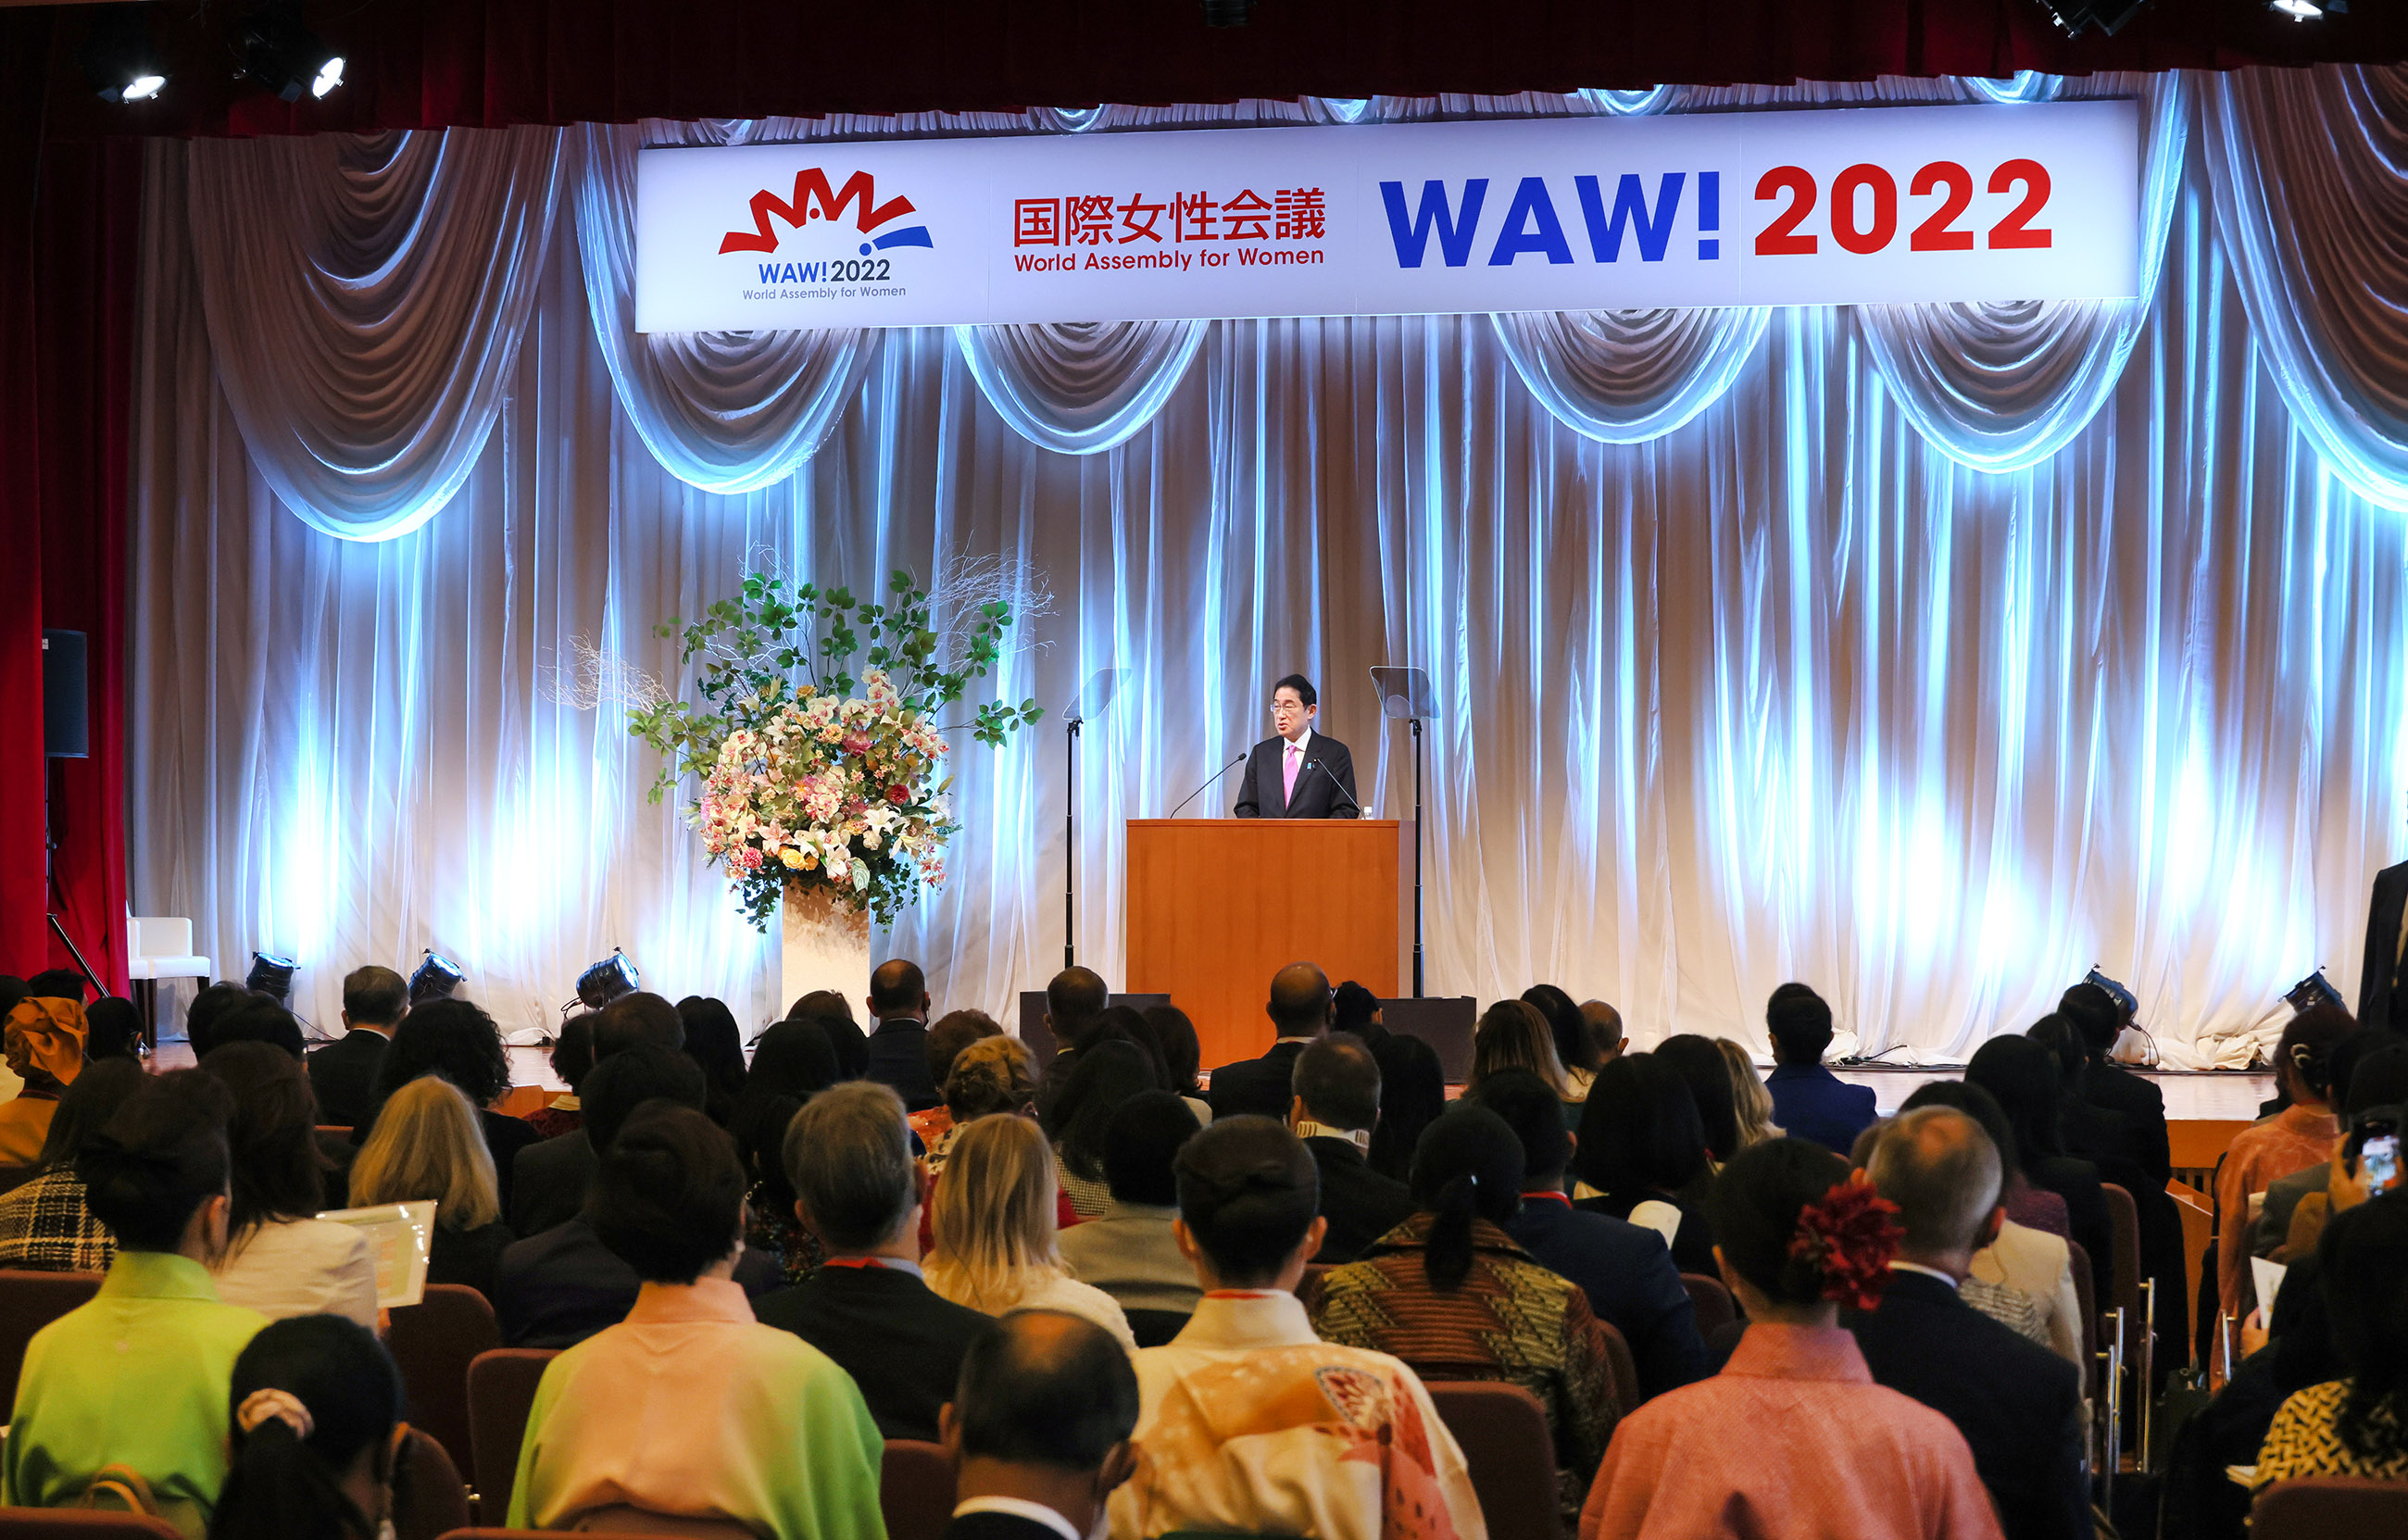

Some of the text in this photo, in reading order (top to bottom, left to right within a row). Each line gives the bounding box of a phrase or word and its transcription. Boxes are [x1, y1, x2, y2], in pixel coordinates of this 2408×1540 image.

[1012, 186, 1327, 248] 国際女性会議
[1379, 157, 2052, 269] WAW! 2022
[1013, 246, 1324, 272] World Assembly for Women
[742, 286, 907, 301] World Assembly for Women
